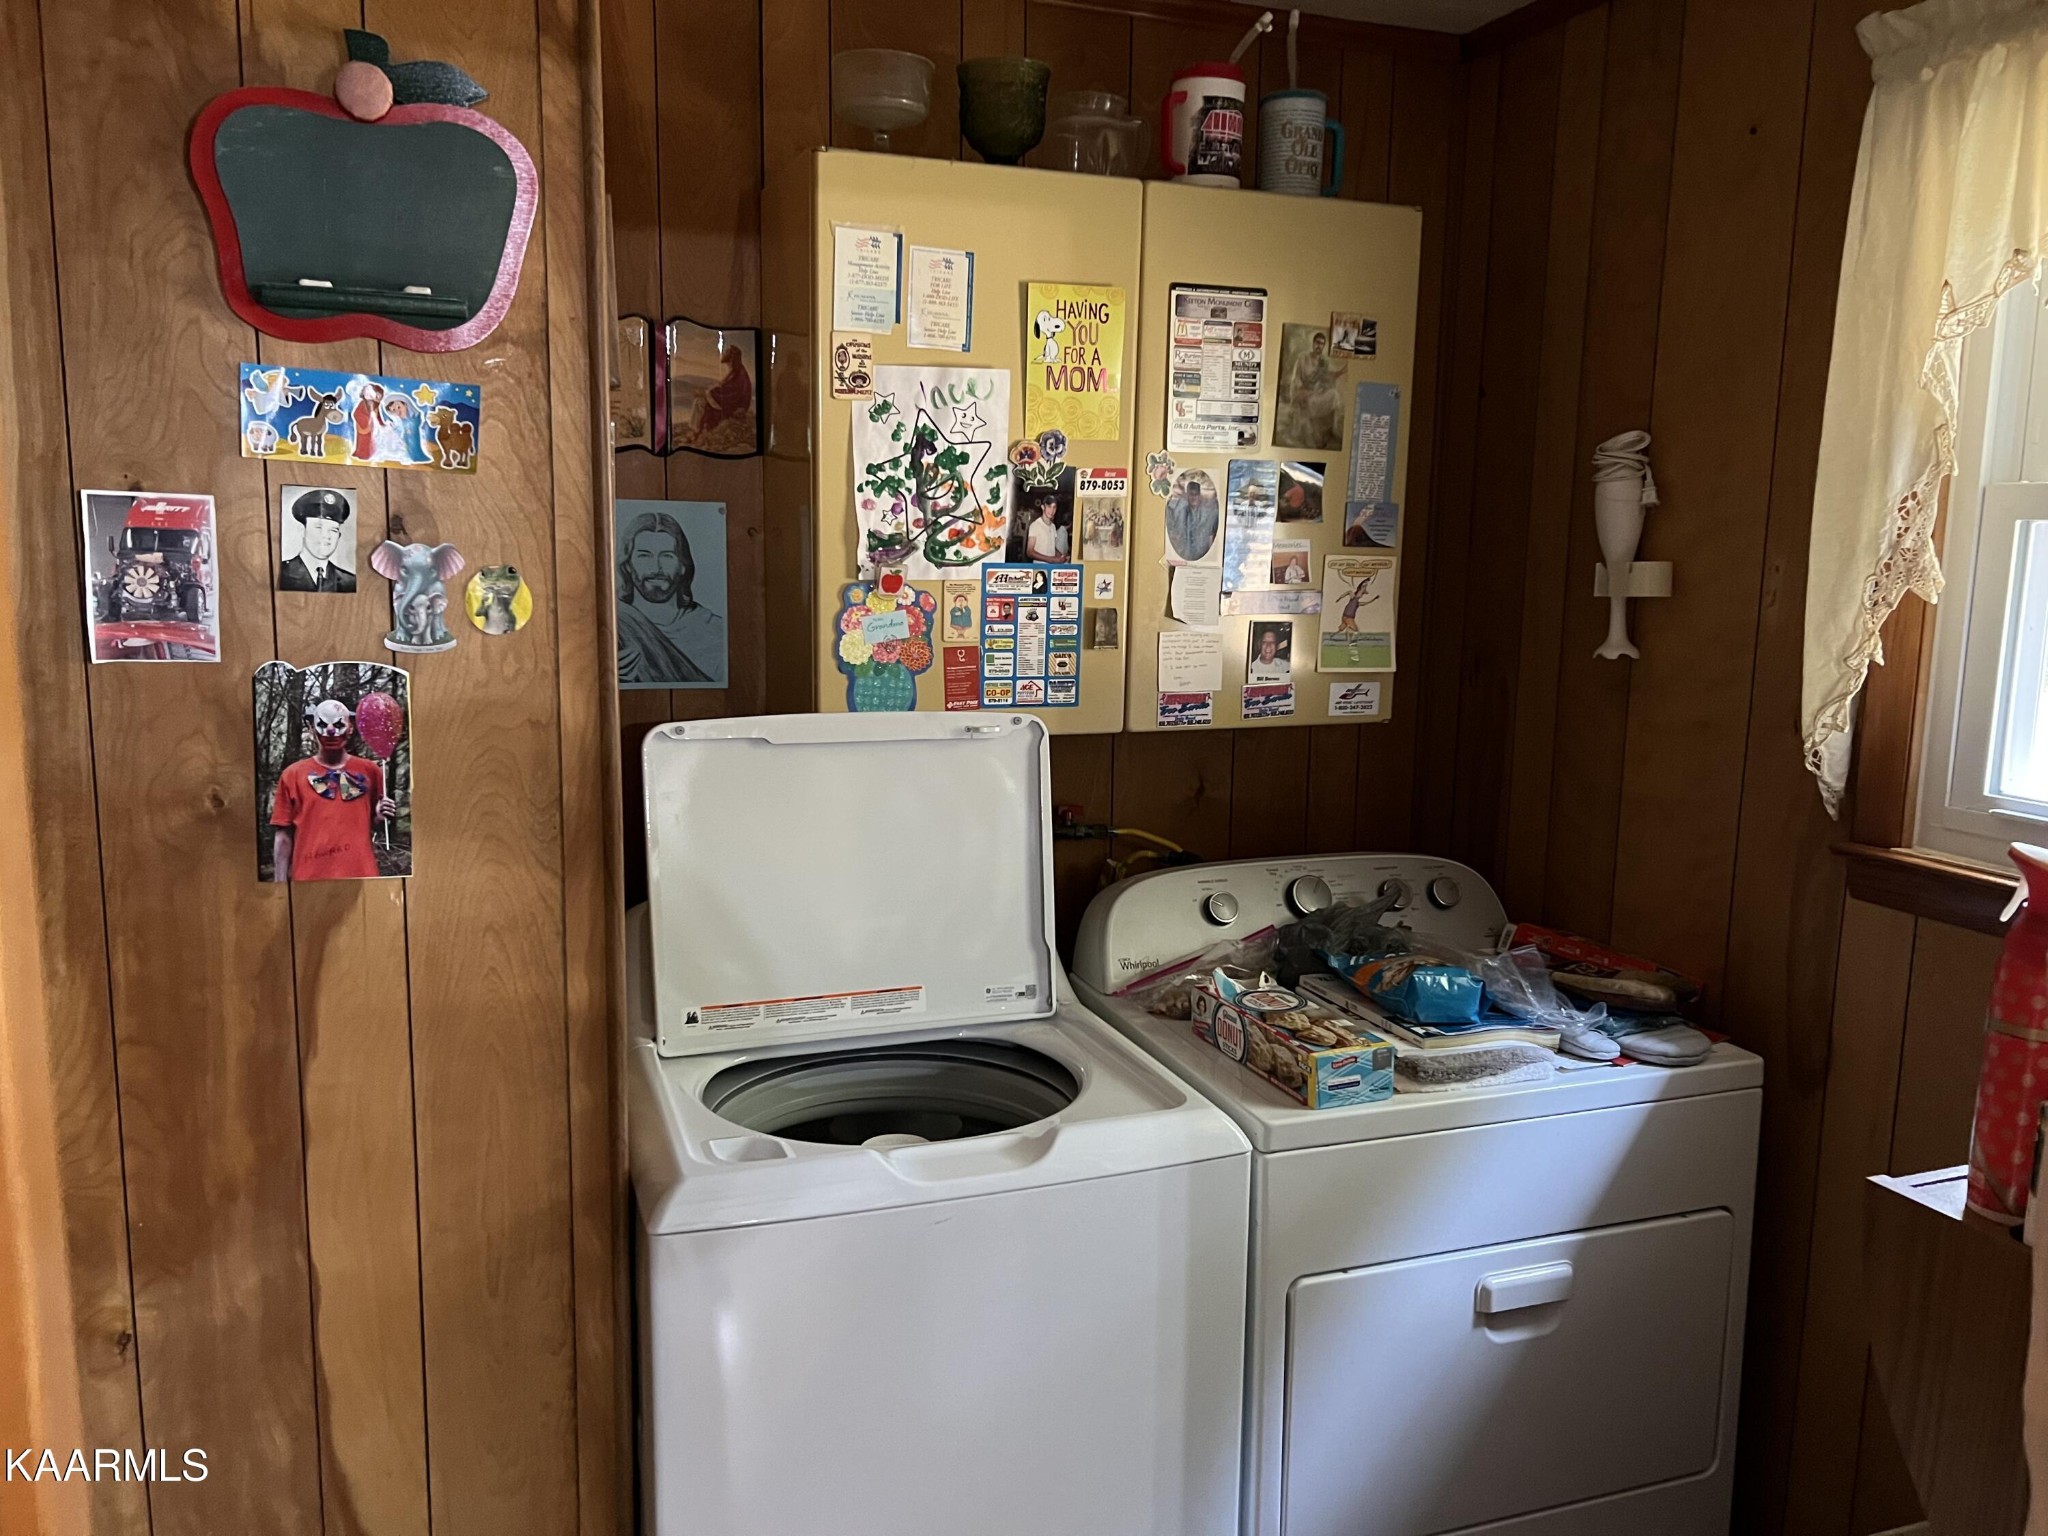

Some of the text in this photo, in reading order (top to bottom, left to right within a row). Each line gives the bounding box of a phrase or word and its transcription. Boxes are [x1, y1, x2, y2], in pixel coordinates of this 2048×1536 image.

[1067, 320, 1099, 346] YOU
[1064, 346, 1101, 366] FOR A
[1080, 480, 1125, 491] 879-8053
[986, 689, 1011, 697] CO-OP
[1119, 958, 1160, 971] Whirlpool
[1217, 1017, 1243, 1049] DONUT
[1221, 1041, 1238, 1056] STICKS
